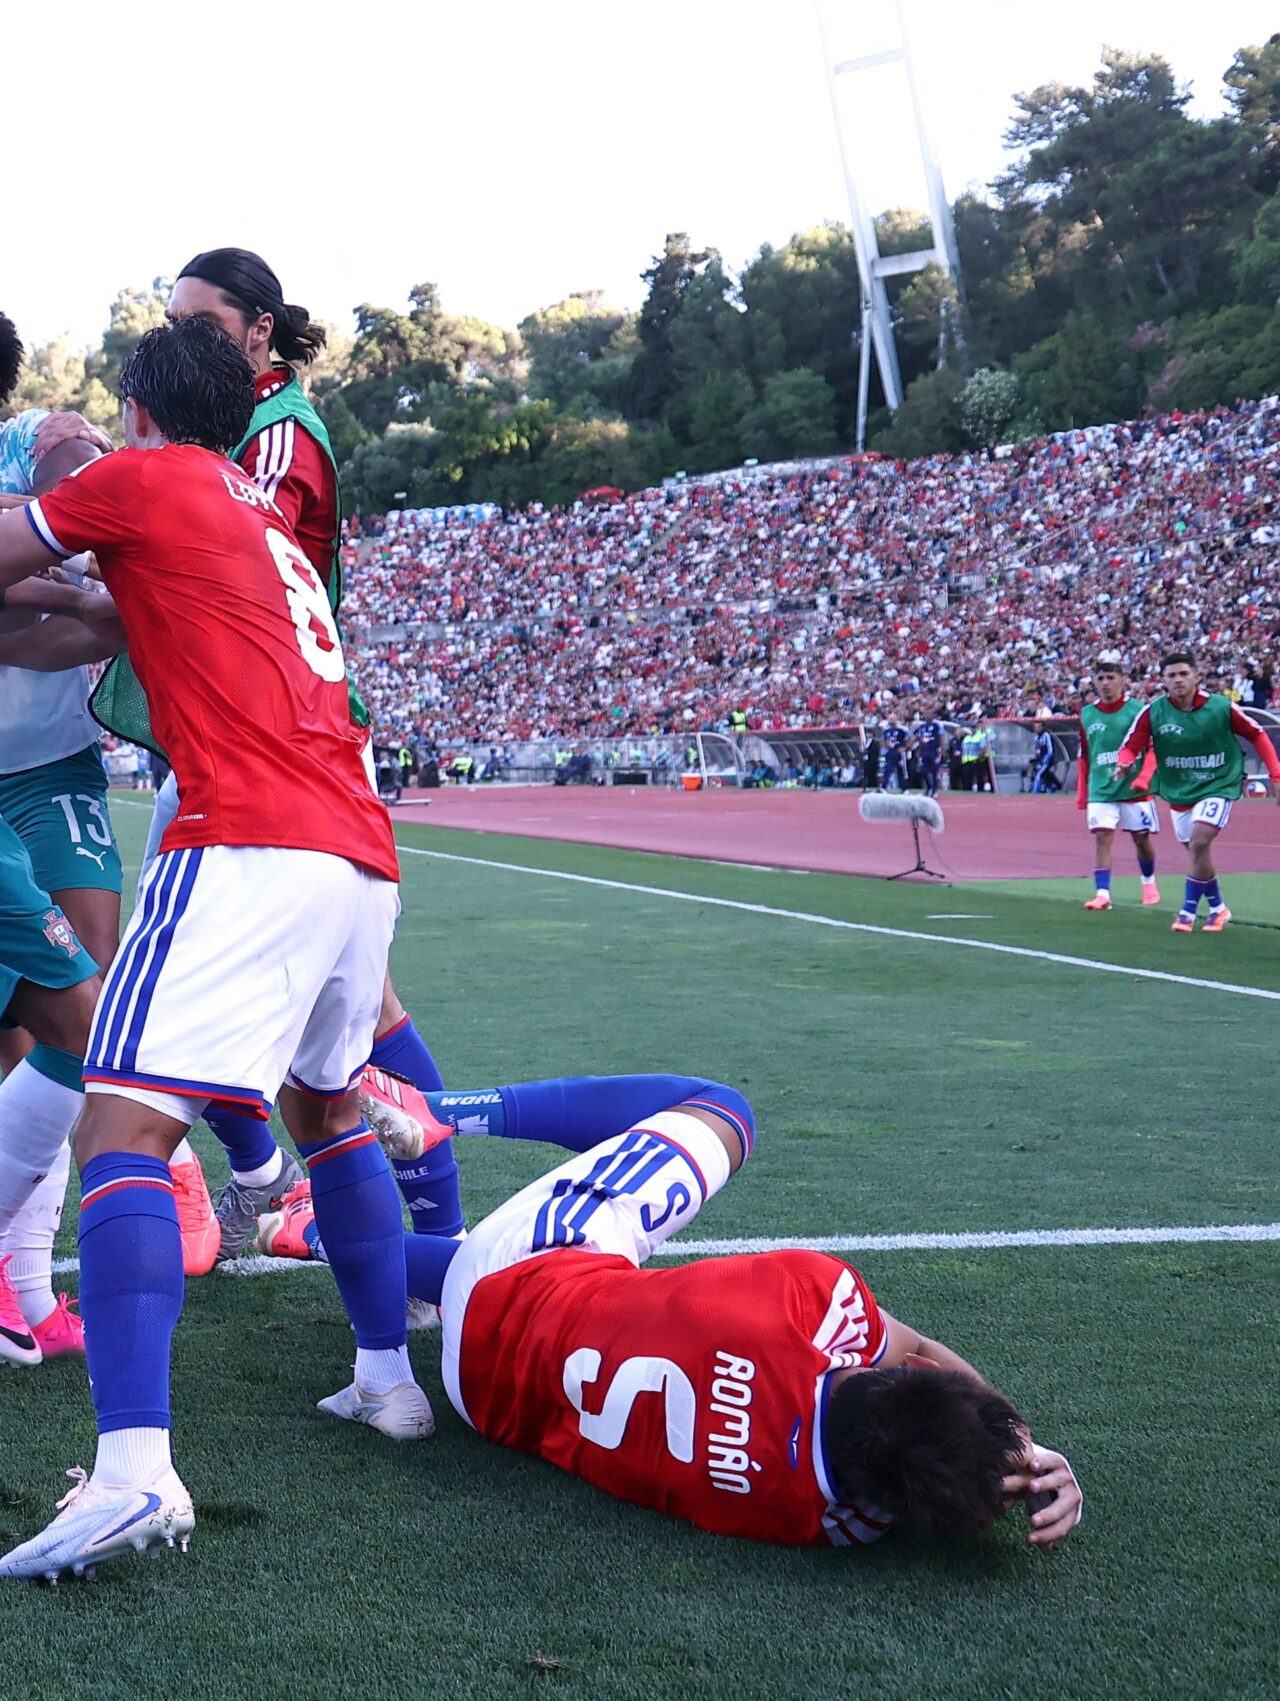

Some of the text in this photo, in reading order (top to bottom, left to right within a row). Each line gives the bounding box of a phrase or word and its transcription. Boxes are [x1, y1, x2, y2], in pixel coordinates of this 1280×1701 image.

[264, 527, 345, 683] 8
[1164, 751, 1226, 769] #FOOTBALL
[51, 794, 112, 847] 13
[1200, 801, 1219, 818] 13
[639, 1181, 692, 1233] 5
[562, 1346, 697, 1464] 5
